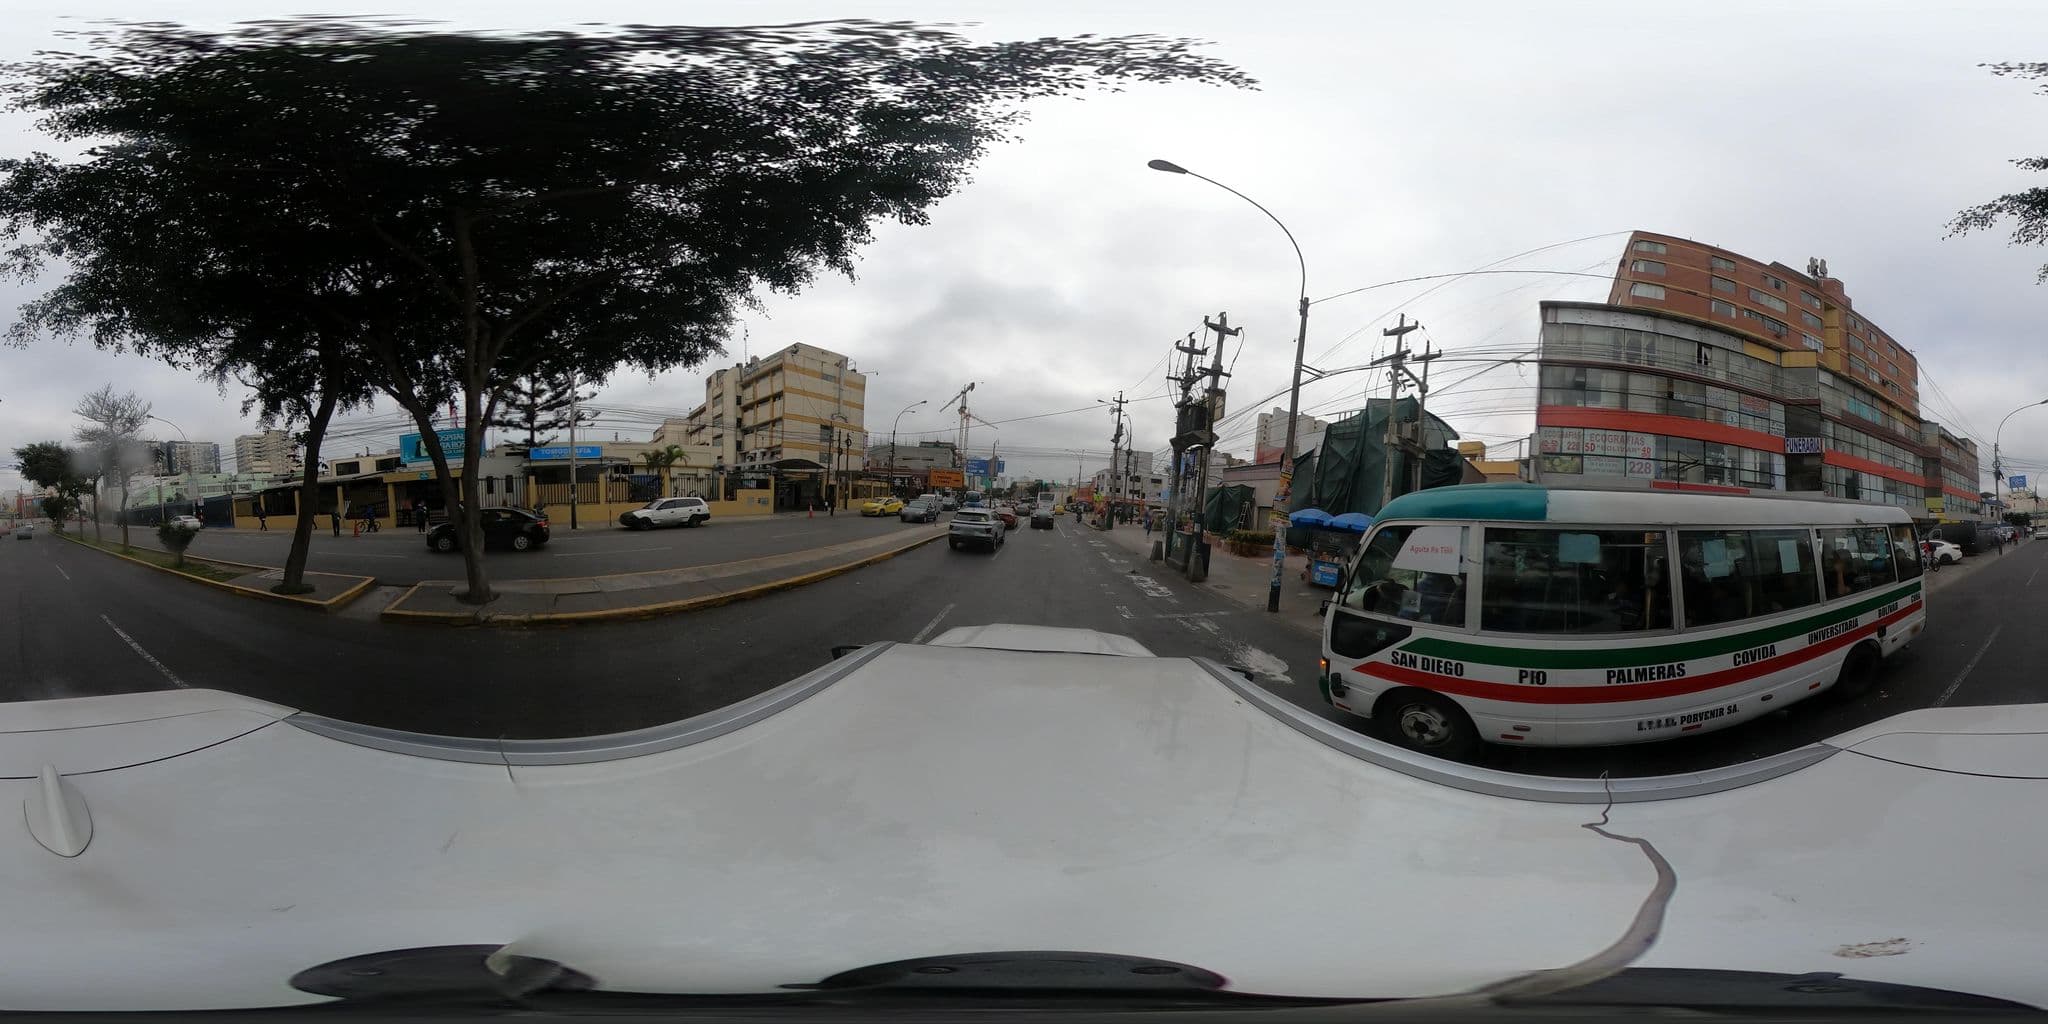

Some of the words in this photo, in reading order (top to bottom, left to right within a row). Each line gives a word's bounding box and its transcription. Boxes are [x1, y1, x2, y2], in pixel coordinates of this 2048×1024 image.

[1589, 433, 1645, 446] ECOGRAFIAS
[1629, 461, 1652, 474] 228
[1391, 650, 1417, 669] SAN
[1421, 657, 1464, 676] DIEGO
[1606, 662, 1686, 684] PALMERAS
[1808, 618, 1859, 645] UNIVERSITARIA
[1680, 707, 1724, 725] PORVENIR
